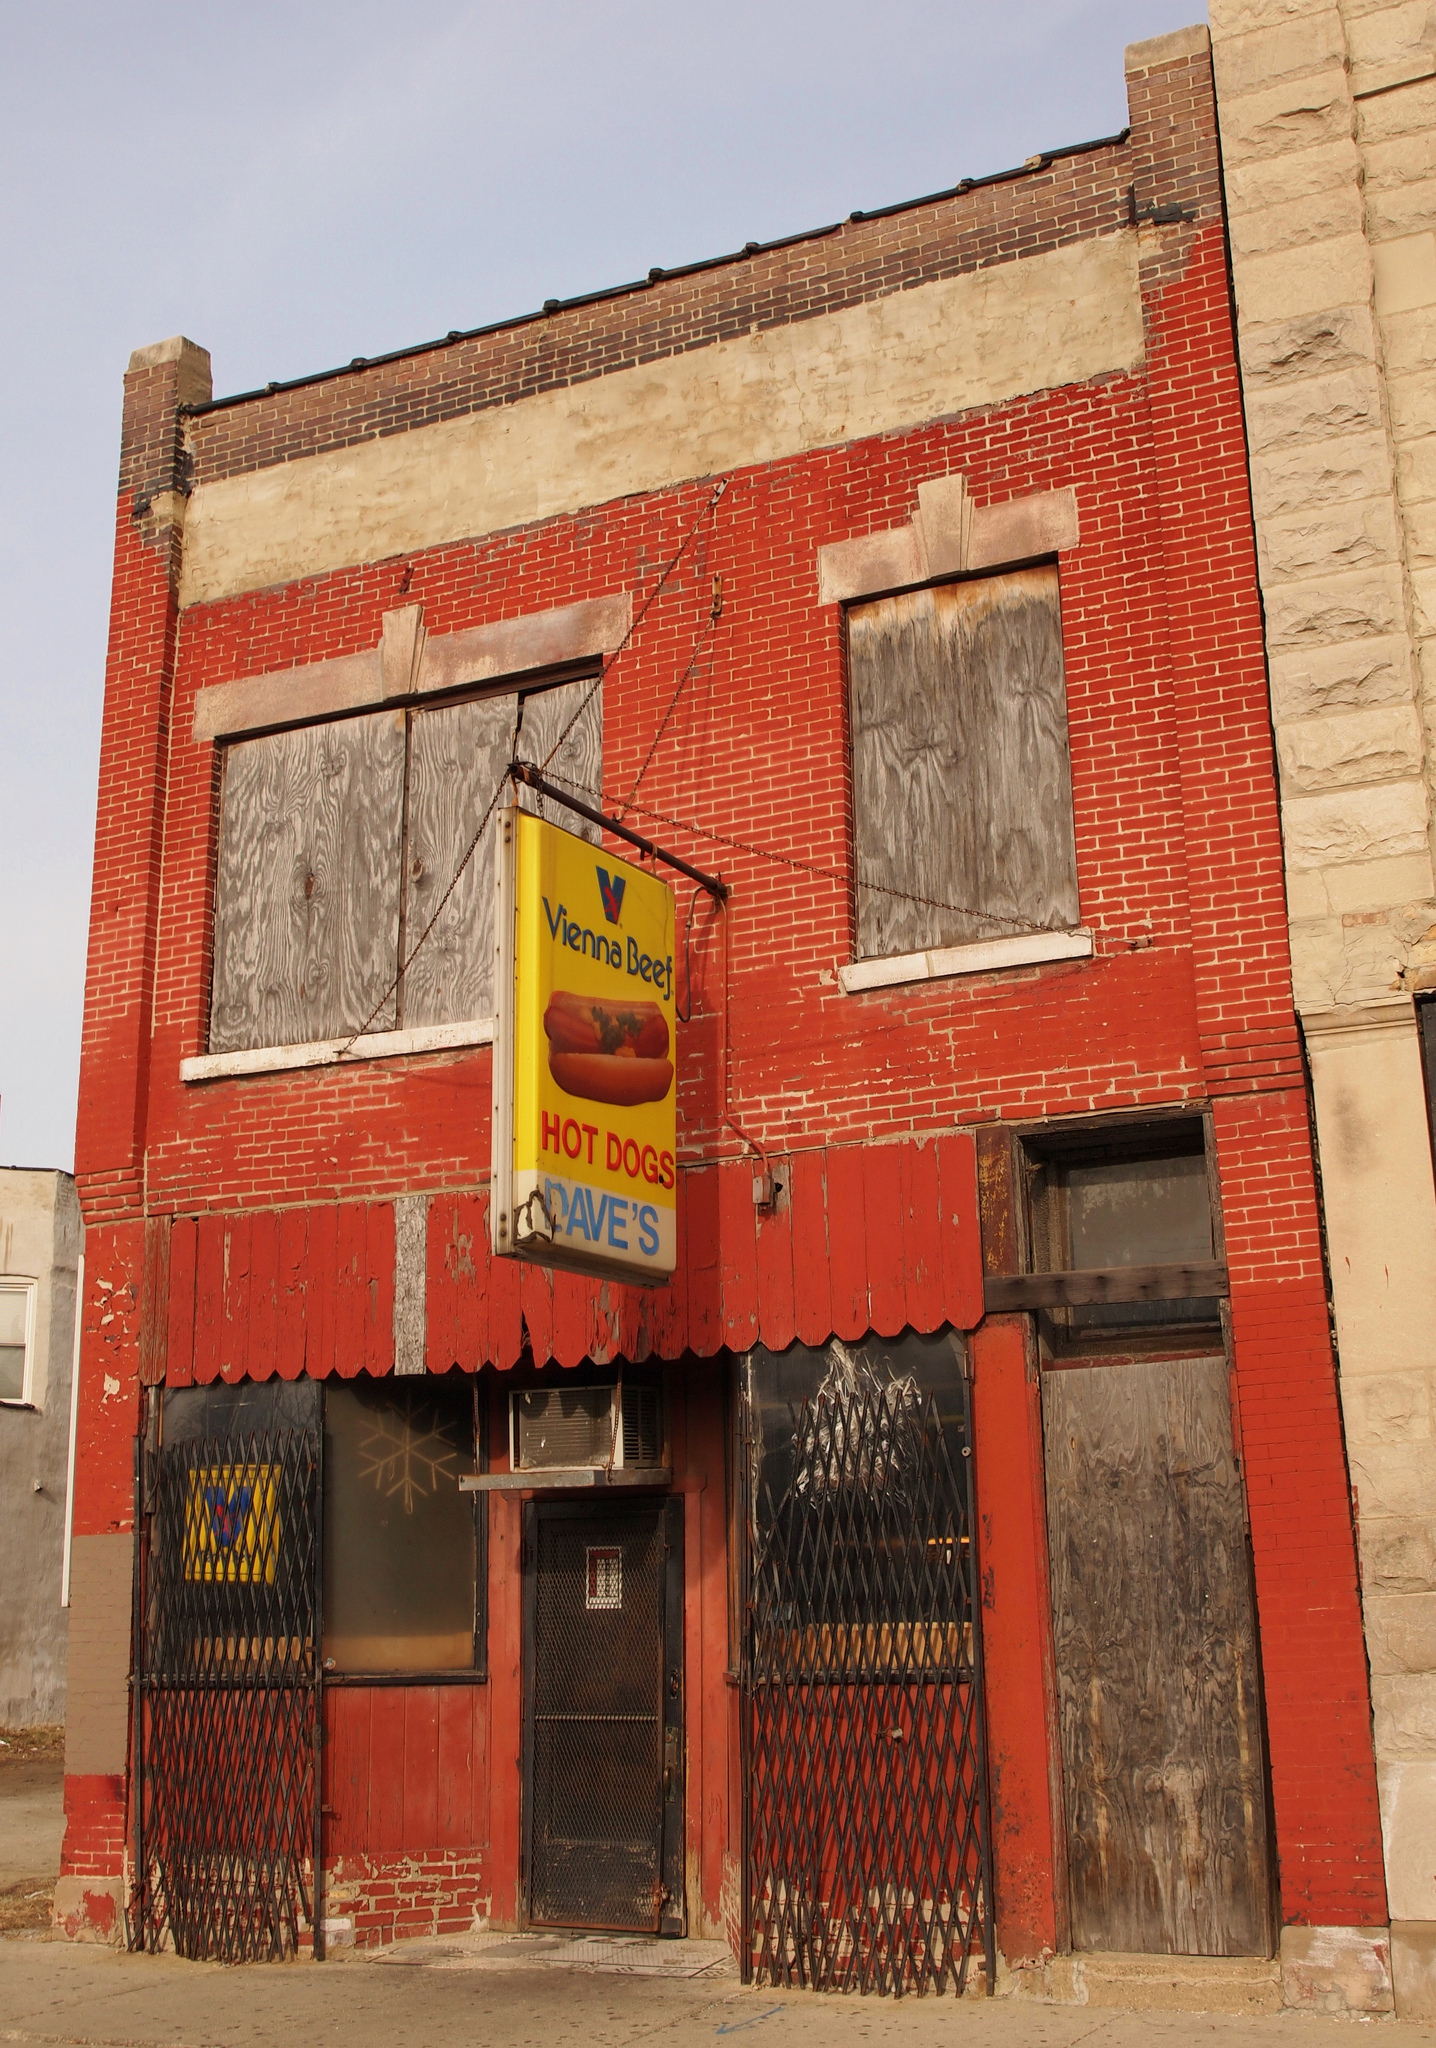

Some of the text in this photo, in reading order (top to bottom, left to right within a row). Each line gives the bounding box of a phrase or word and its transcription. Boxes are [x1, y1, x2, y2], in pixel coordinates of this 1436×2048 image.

[542, 896, 673, 1001] Vienna Beef
[542, 1110, 675, 1189] HOT DOGS
[544, 1177, 659, 1256] DAVE'S
